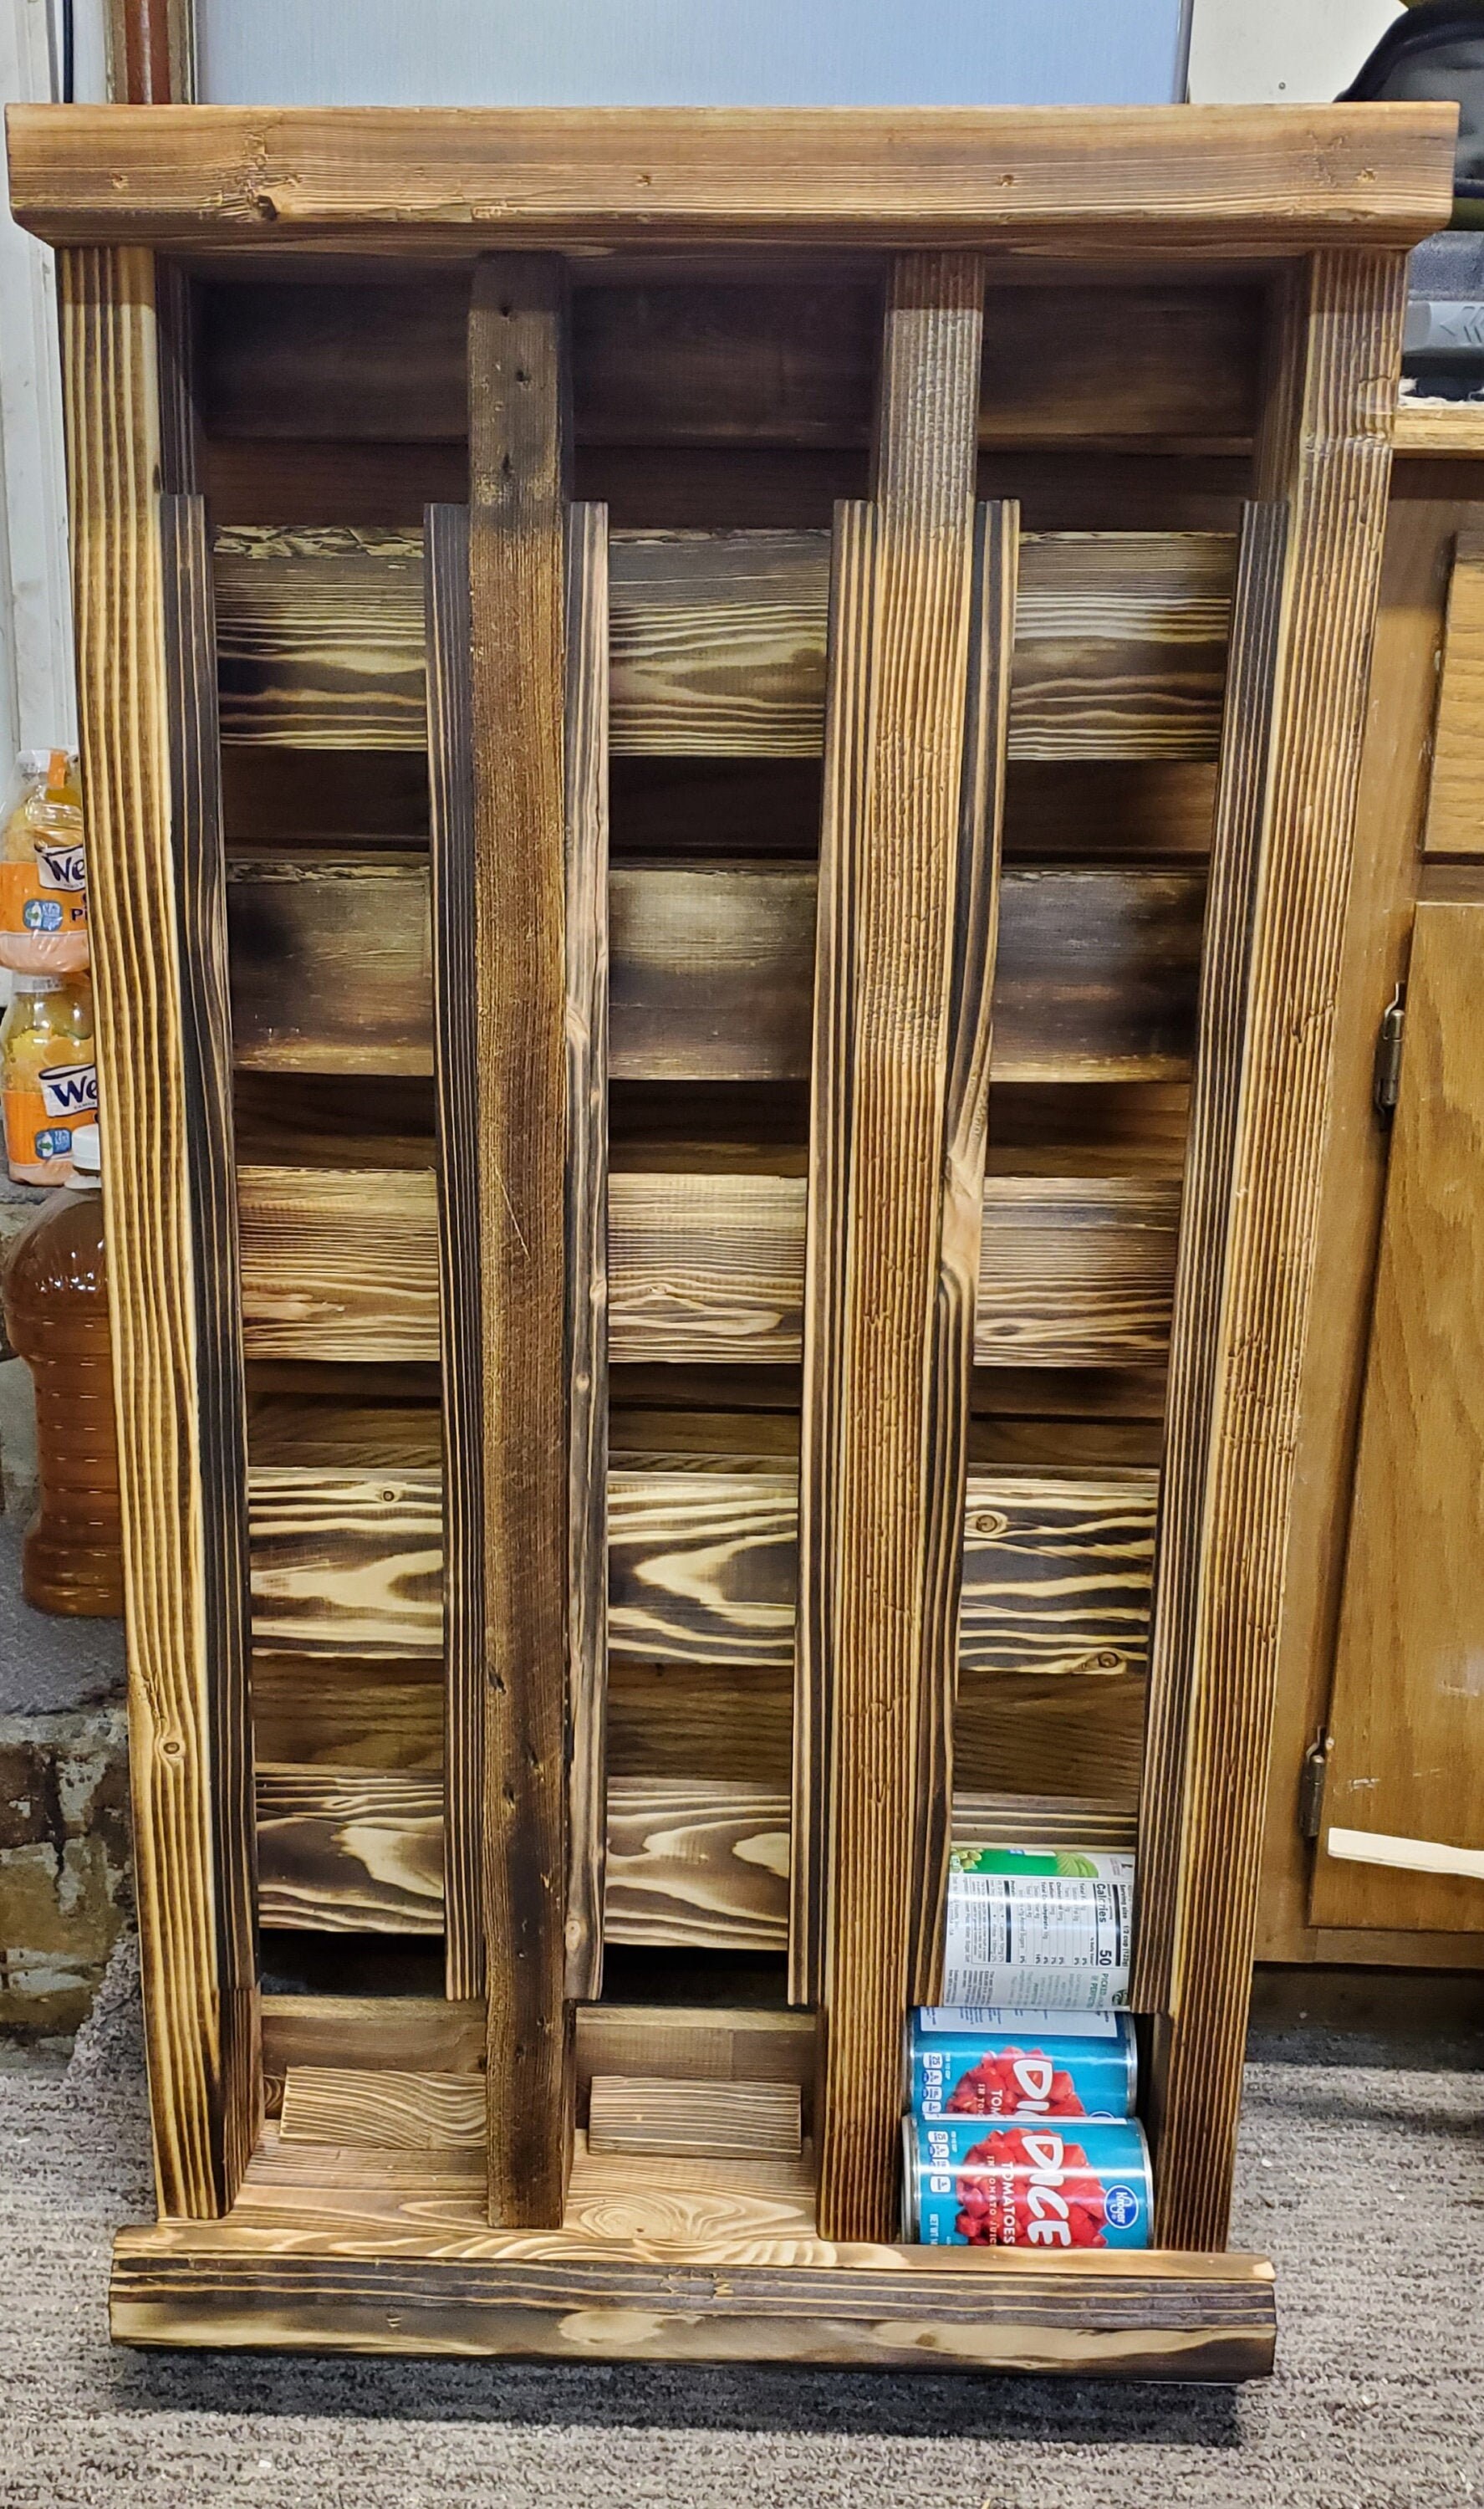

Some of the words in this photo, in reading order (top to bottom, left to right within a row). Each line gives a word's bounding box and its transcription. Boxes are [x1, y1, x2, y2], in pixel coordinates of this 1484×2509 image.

[1097, 1883, 1108, 1923] Calories
[1099, 1949, 1112, 1965] 50
[1002, 2162, 1015, 2244] TOMATOES
[1110, 2192, 1132, 2224] Kroger
